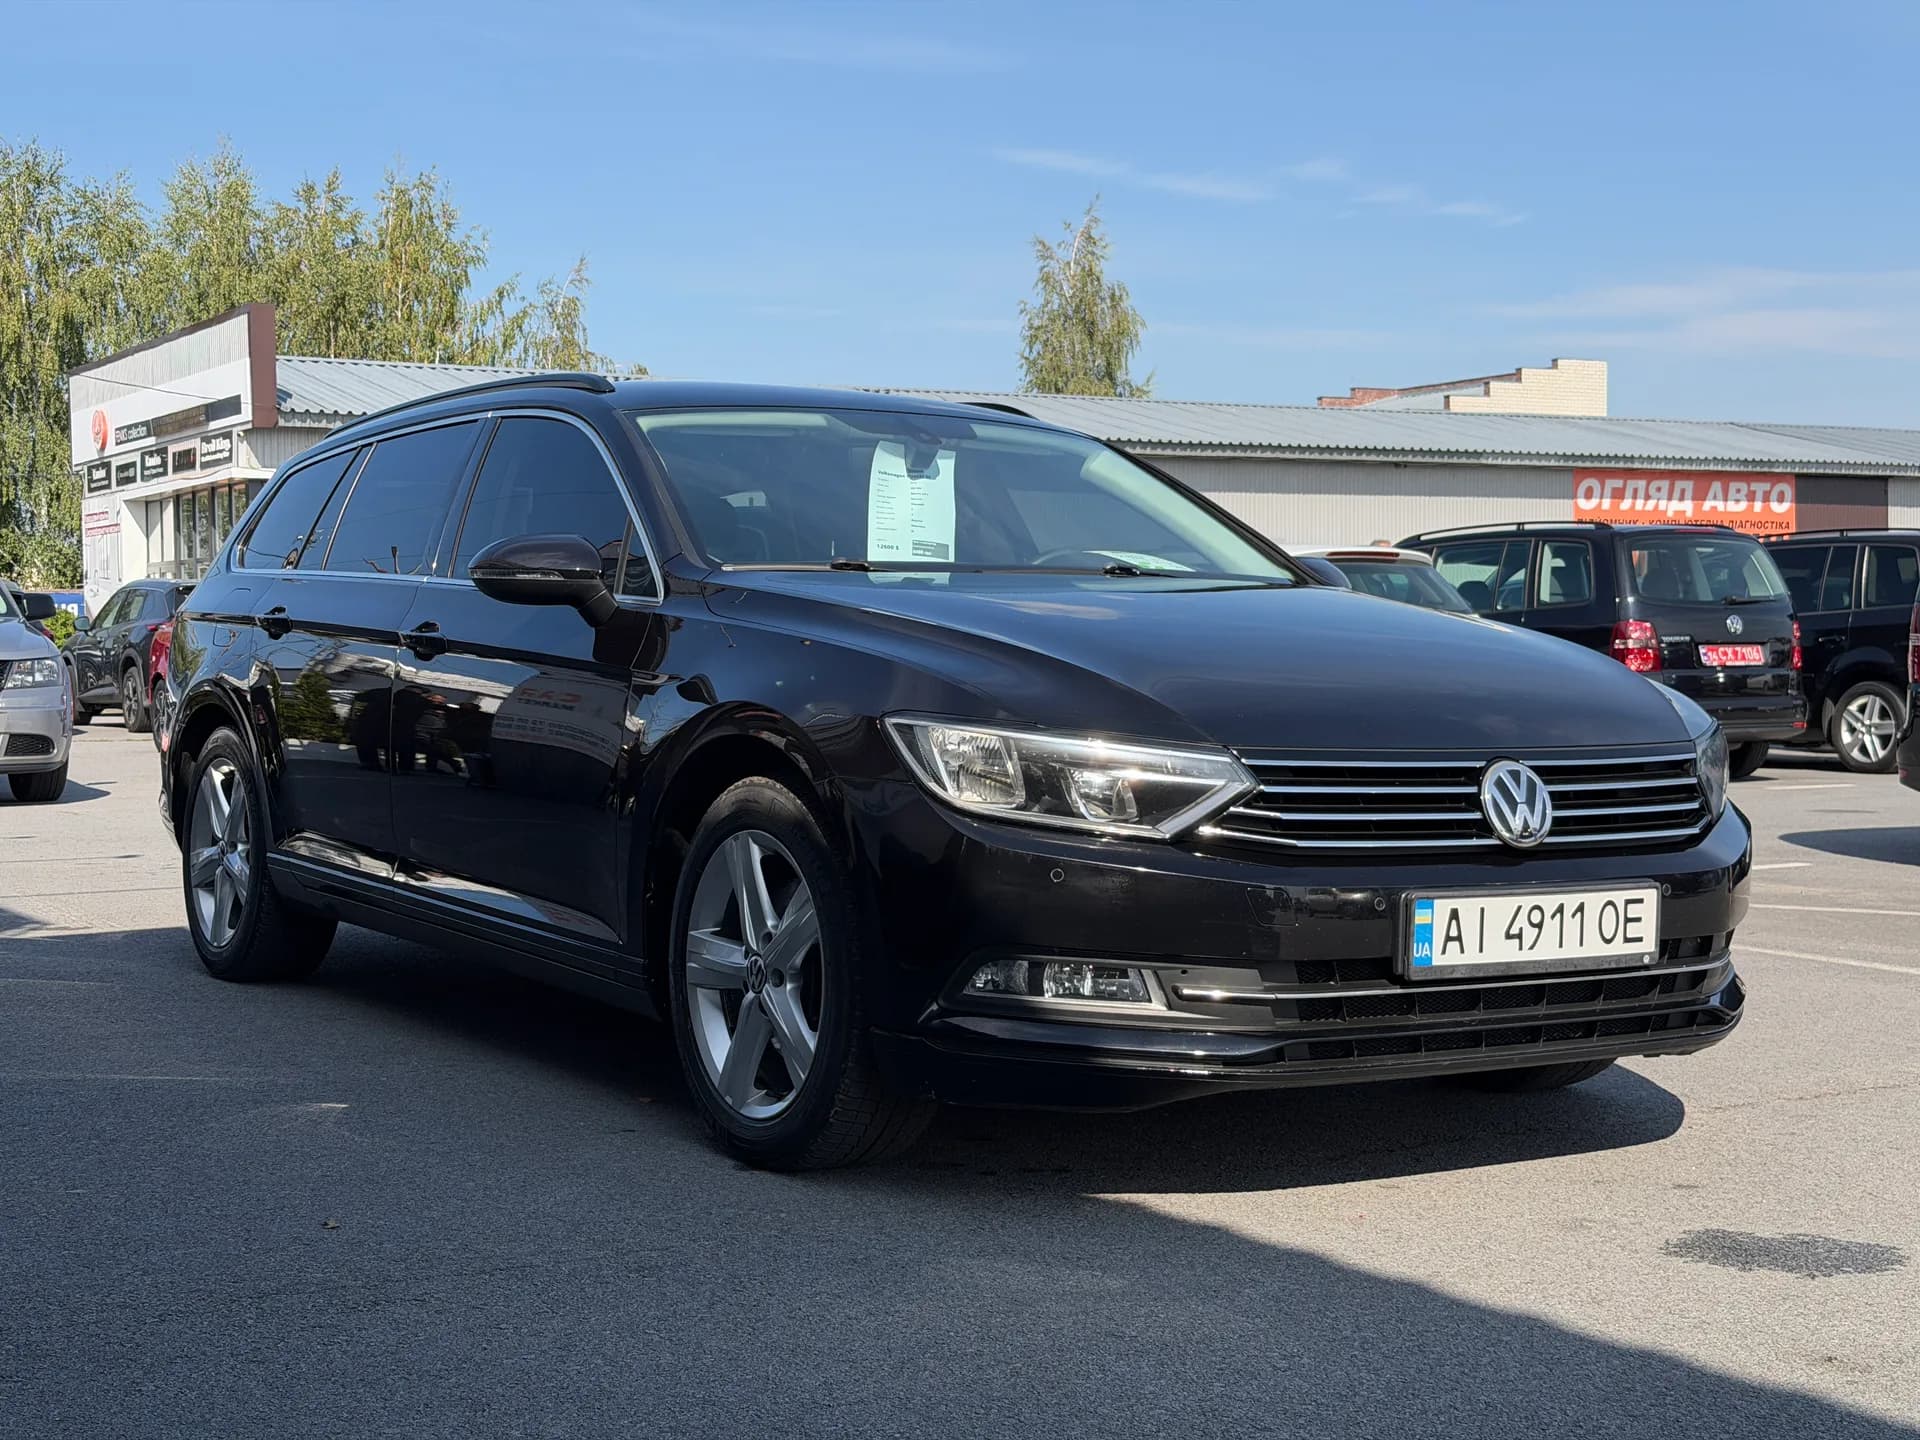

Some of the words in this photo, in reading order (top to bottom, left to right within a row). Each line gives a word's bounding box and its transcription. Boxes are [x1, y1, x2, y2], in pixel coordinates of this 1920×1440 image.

[1576, 478, 1695, 517] ОГЛЯД
[1702, 480, 1792, 514] АВТО
[1440, 906, 1485, 955] AI
[1505, 901, 1585, 951] 4911
[1598, 897, 1645, 945] OE
[1414, 942, 1431, 957] UA
